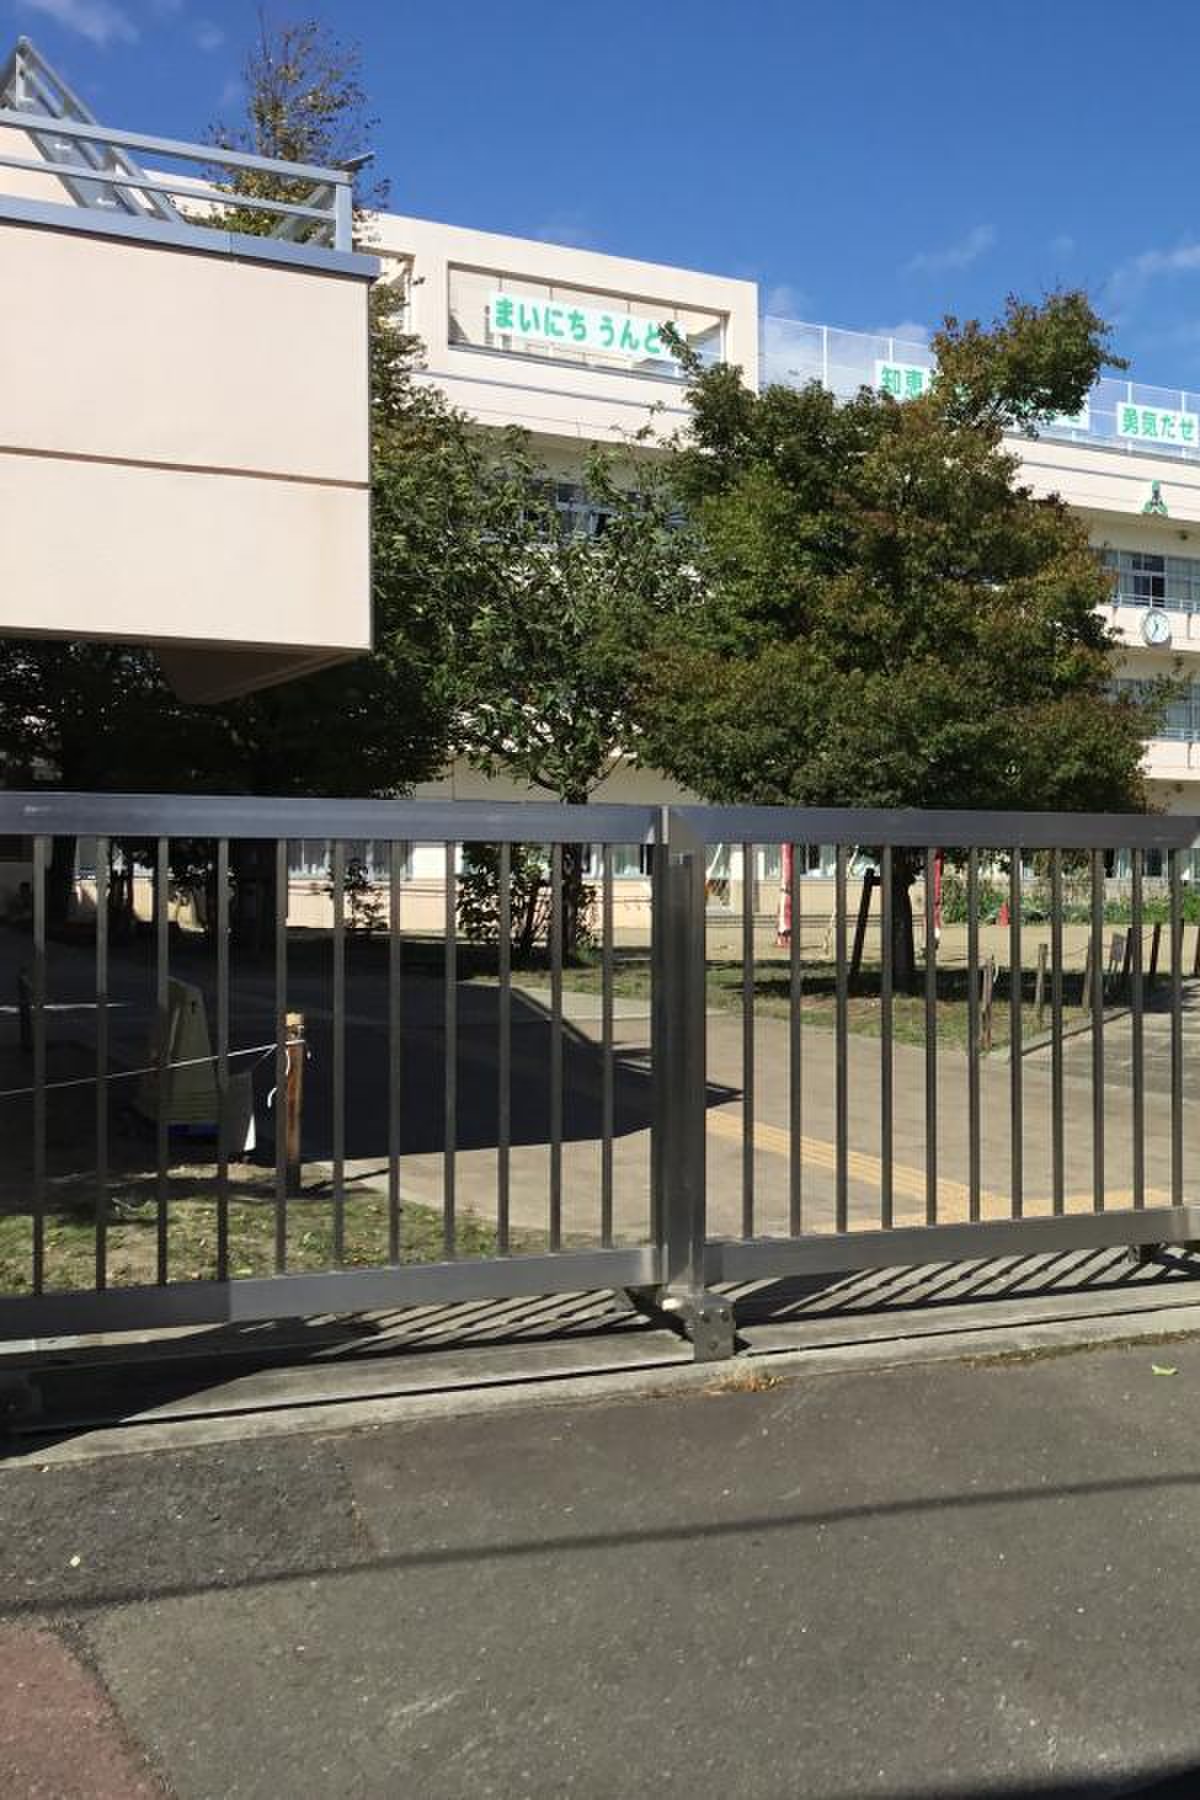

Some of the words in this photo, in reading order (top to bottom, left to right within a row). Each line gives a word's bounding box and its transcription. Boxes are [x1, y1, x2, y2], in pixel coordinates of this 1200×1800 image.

[494, 296, 588, 342] まいにち
[1122, 406, 1195, 441] 勇気だせ
